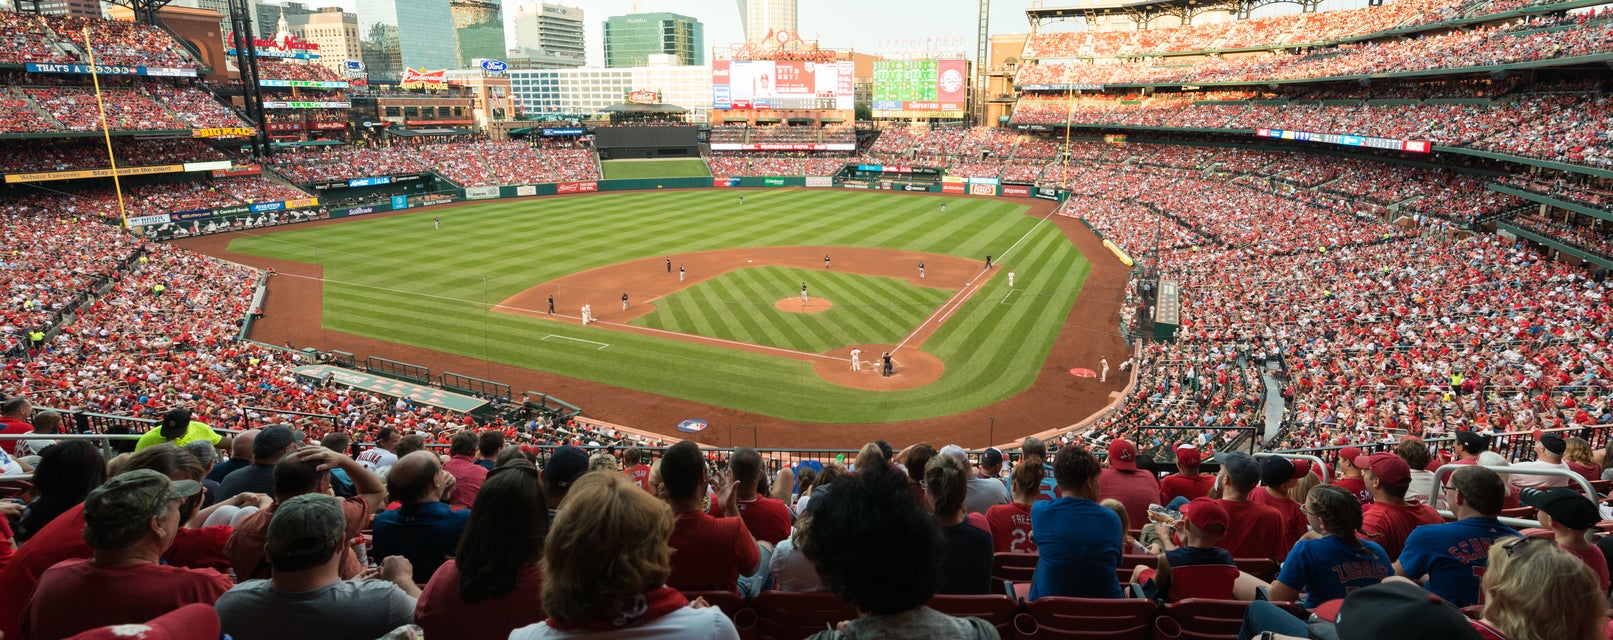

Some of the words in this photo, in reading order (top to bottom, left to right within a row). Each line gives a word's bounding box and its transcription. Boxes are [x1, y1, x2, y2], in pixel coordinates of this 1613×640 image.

[227, 32, 278, 49] Cinals
[279, 36, 319, 51] Nation
[36, 64, 69, 72] THAT'S
[405, 71, 446, 81] Budweiser
[201, 129, 221, 137] BIG
[221, 128, 249, 136] MAC
[92, 169, 108, 177] Stay
[973, 184, 992, 195] Lay's
[348, 207, 372, 215] Scottrade
[1011, 514, 1032, 526] FREE
[1448, 537, 1492, 565] SCHW
[1331, 560, 1389, 584] ZOBRIST
